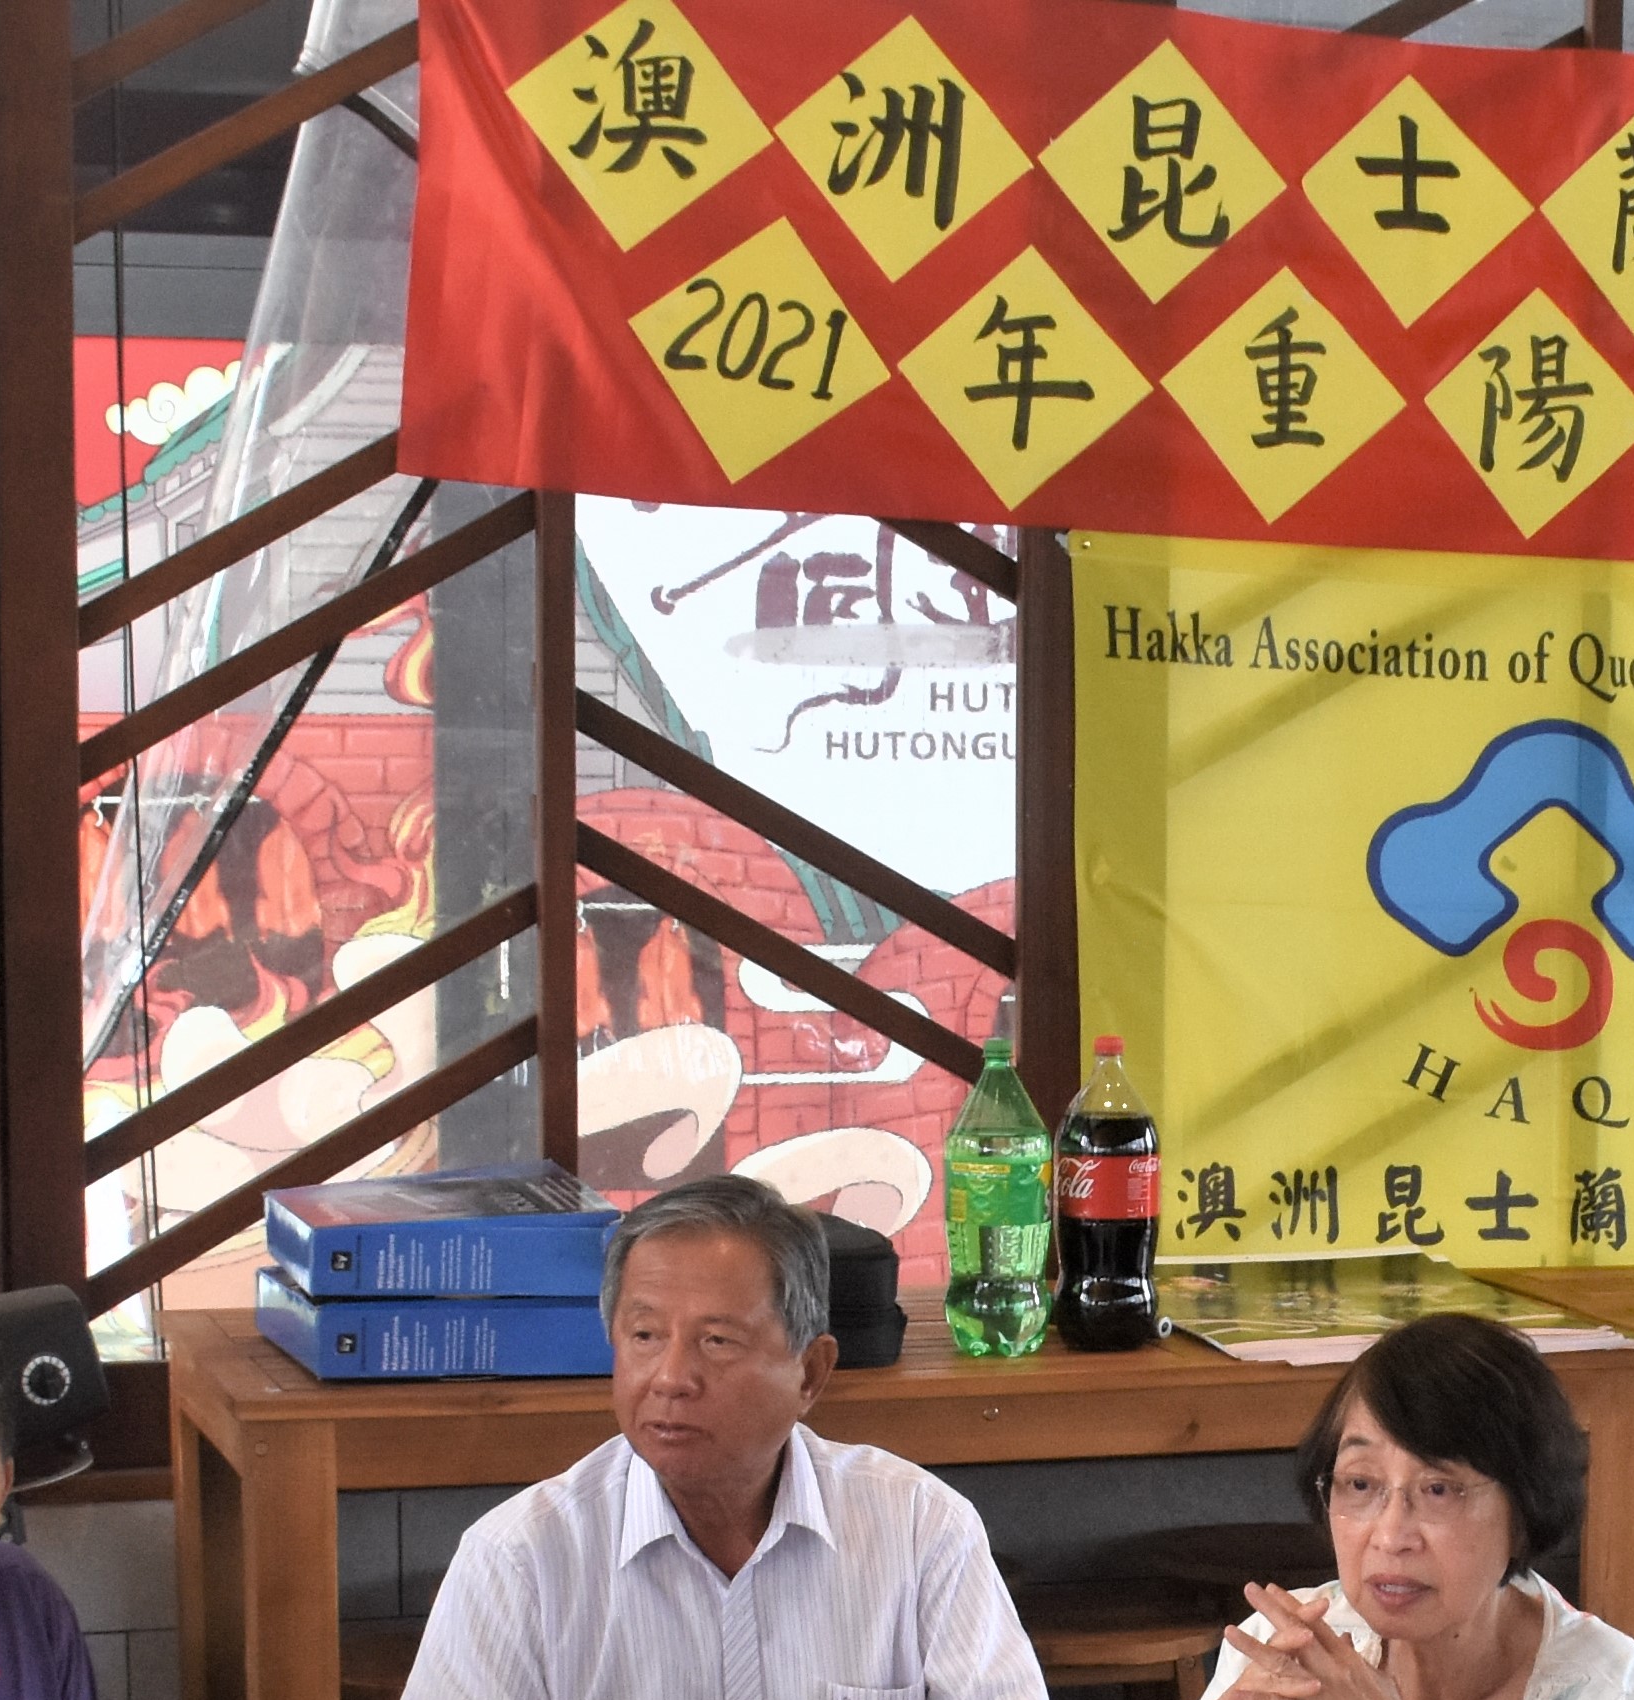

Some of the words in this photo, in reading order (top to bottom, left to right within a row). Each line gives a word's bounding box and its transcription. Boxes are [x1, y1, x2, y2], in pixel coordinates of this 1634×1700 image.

[1103, 605, 1234, 670] Hakka
[1249, 614, 1490, 684] Association
[1507, 632, 1554, 684] of
